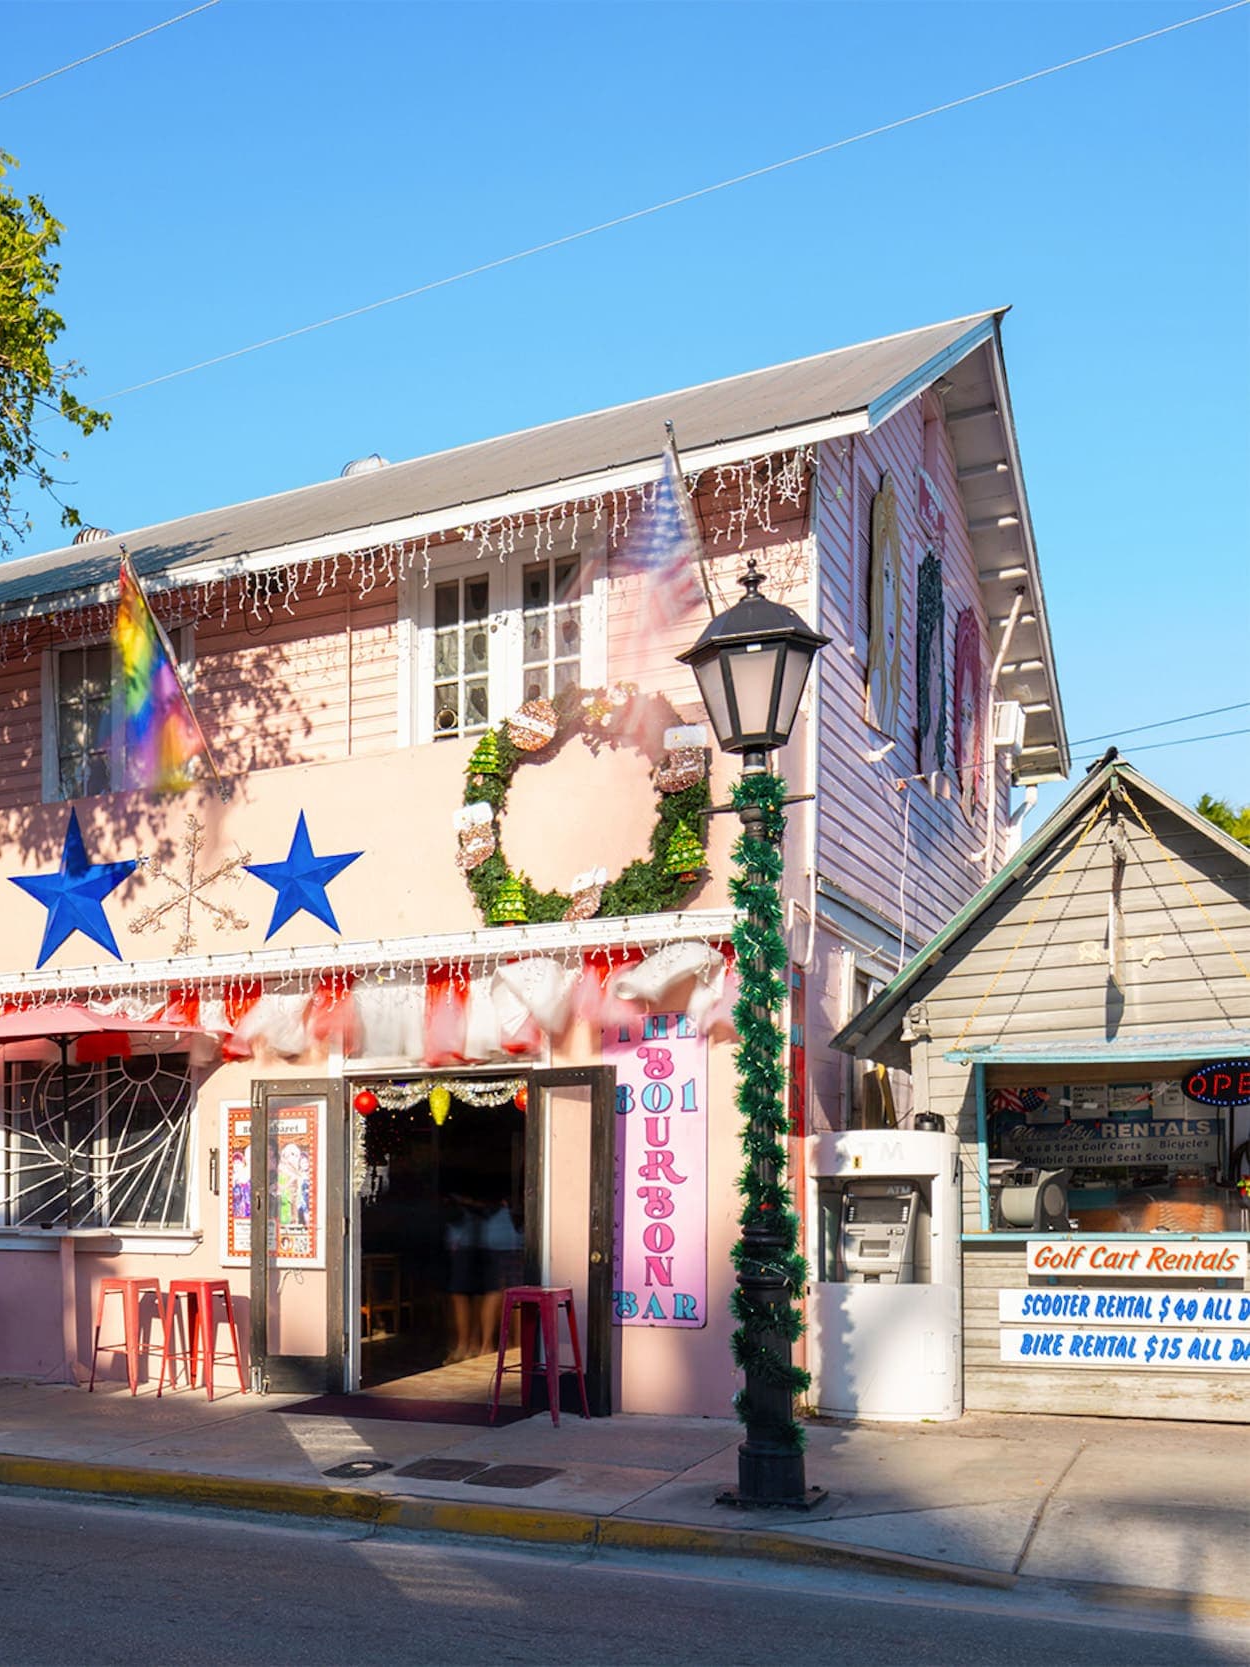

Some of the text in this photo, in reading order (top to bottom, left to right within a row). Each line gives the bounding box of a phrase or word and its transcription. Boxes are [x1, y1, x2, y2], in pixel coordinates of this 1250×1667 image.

[615, 1078, 699, 1115] 801
[1101, 1120, 1211, 1138] RENTALS
[1024, 1155, 1064, 1166] Double
[1077, 1153, 1113, 1165] Single
[1117, 1153, 1142, 1163] Seat
[1145, 1151, 1199, 1162] Scooters
[1054, 1143, 1079, 1153] Seat
[1082, 1142, 1105, 1152] Golf
[1110, 1141, 1141, 1151] Carts
[1159, 1139, 1209, 1150] Bicycles
[636, 1046, 688, 1287] BOURBON
[886, 1185, 911, 1195] ATM
[1034, 1245, 1240, 1272] Golf Cart Rentals
[612, 1290, 699, 1321] BAR
[1021, 1293, 1091, 1318] SCOOTER
[1094, 1294, 1152, 1319] RENTAL
[1202, 1297, 1232, 1321] ALL
[1019, 1333, 1065, 1356] BIKE
[1068, 1335, 1137, 1359] RENTAL
[1144, 1334, 1183, 1363] $15
[1187, 1337, 1222, 1361] ALL
